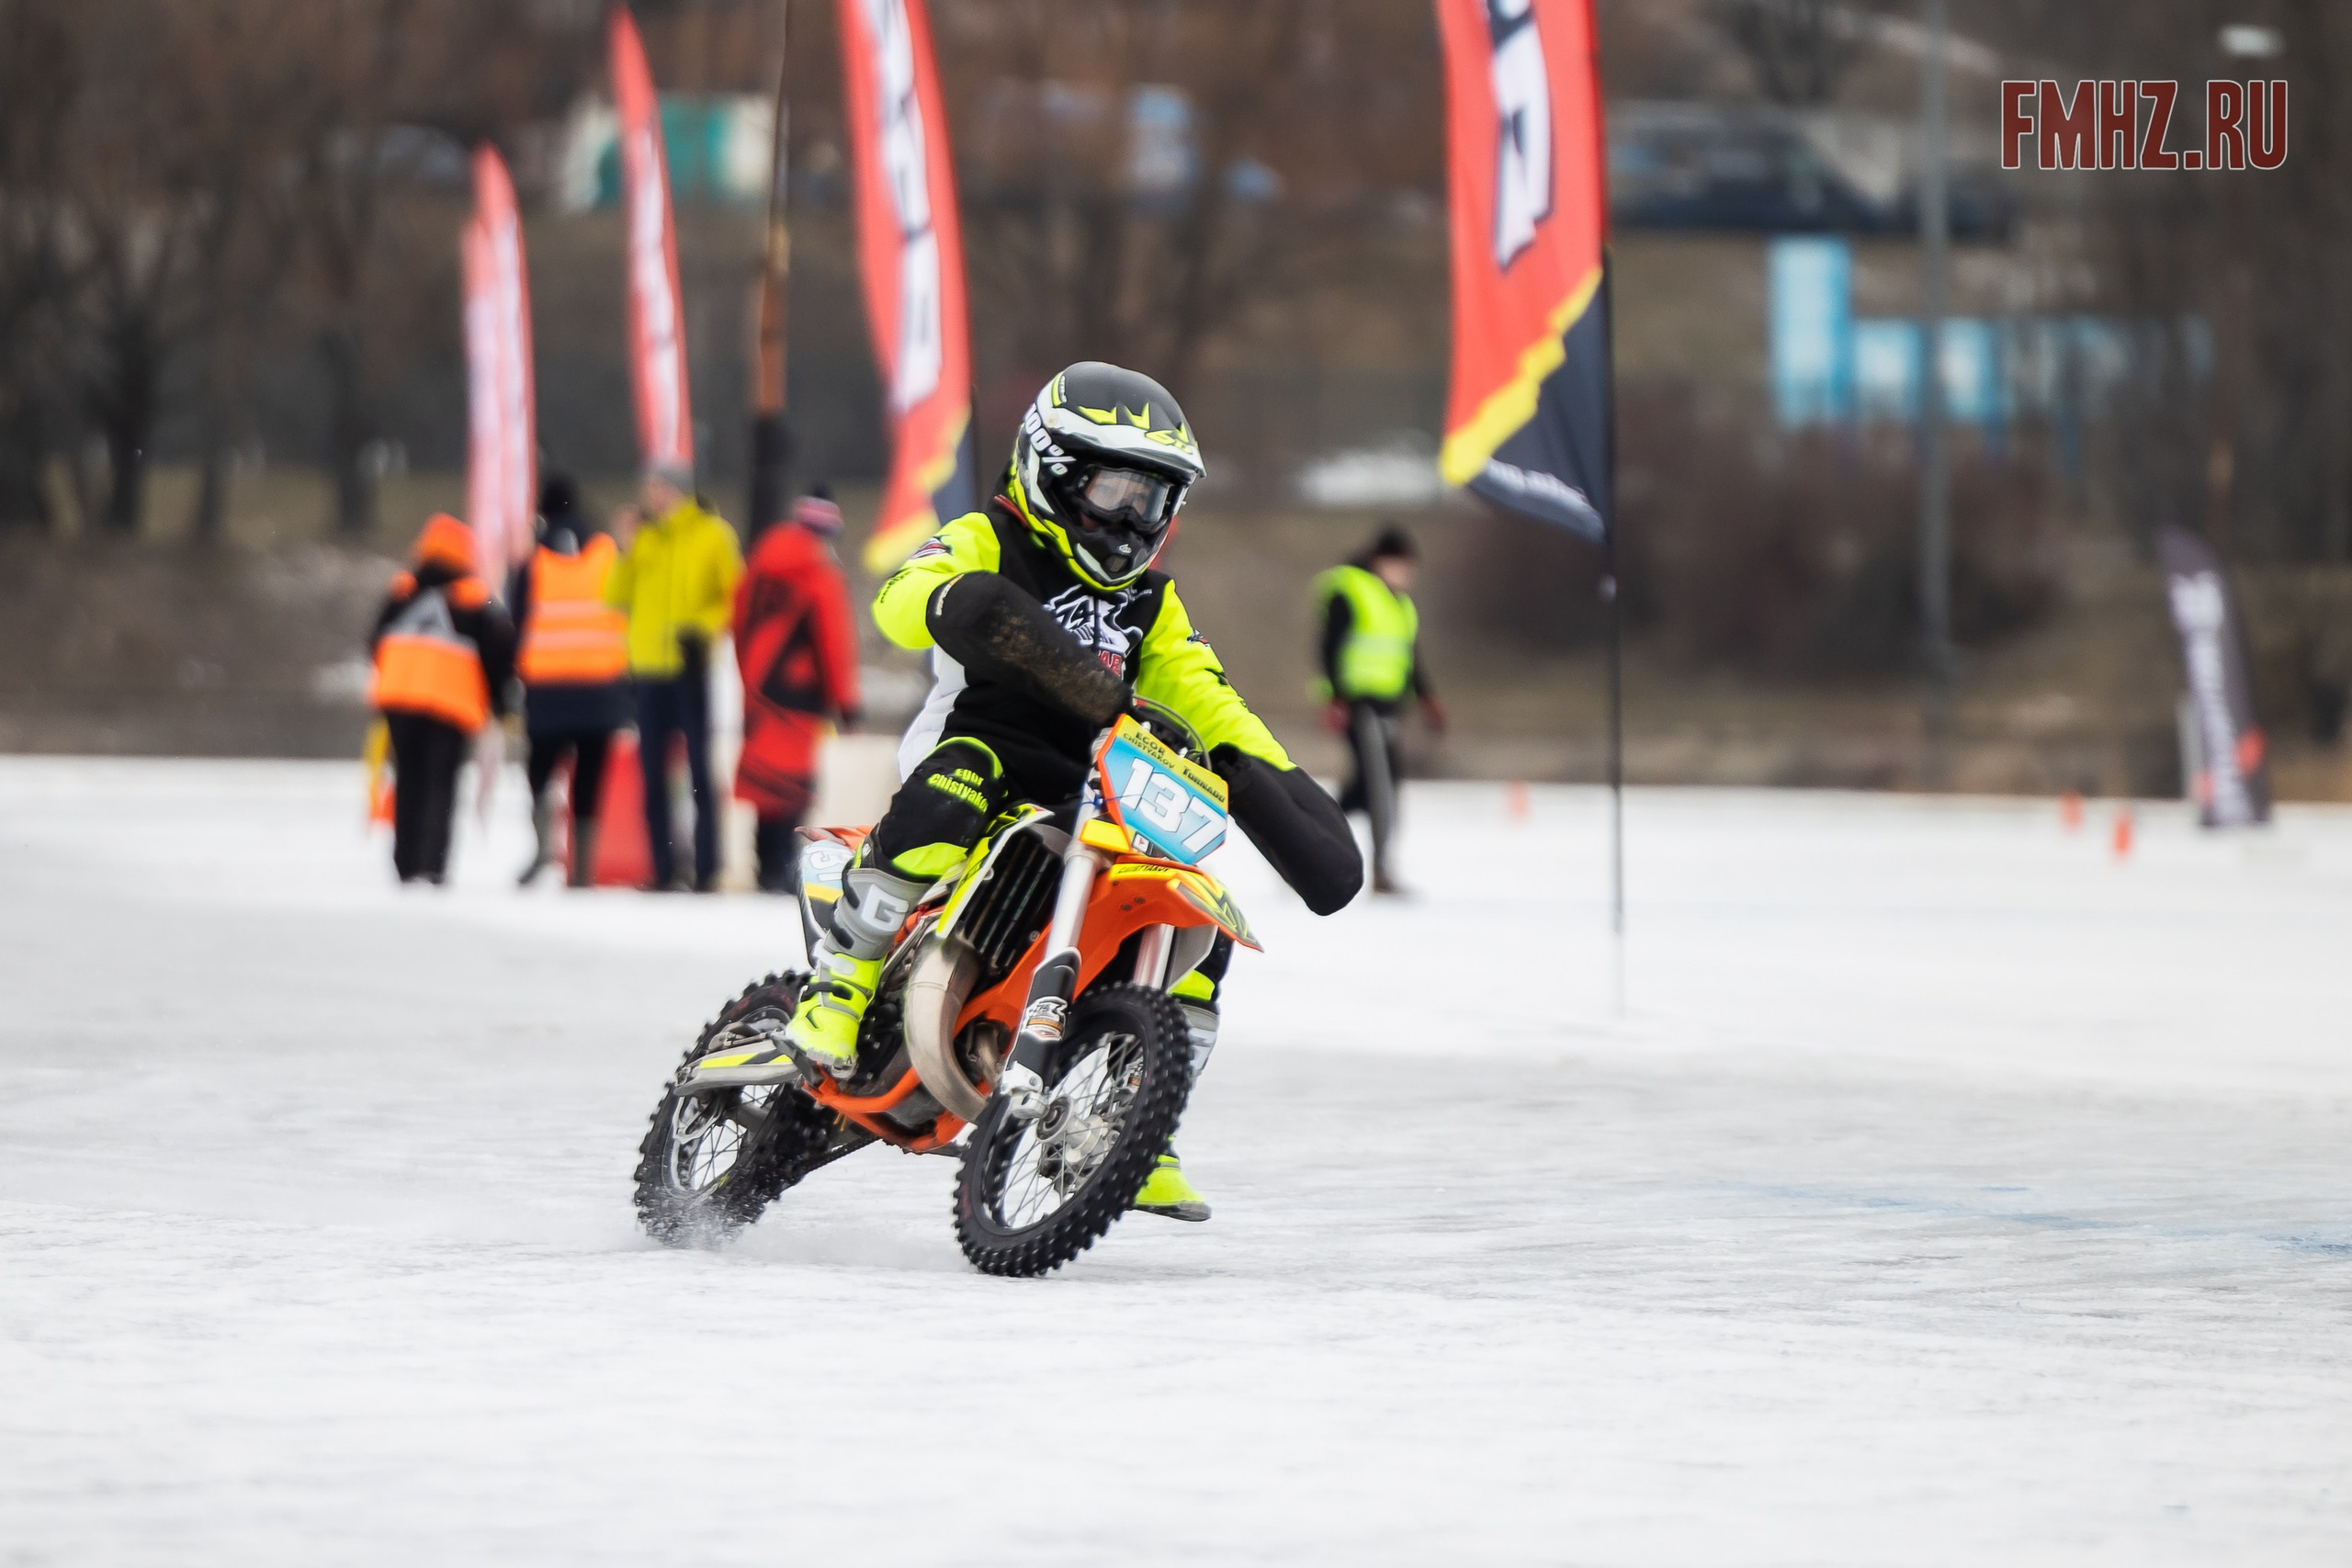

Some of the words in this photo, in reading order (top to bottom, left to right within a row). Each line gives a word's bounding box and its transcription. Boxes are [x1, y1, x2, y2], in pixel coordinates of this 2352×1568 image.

[1025, 402, 1077, 476] 100%
[1123, 733, 1176, 770] CHISTYAKOV
[1136, 731, 1166, 756] EGOR
[1120, 757, 1227, 854] 137
[861, 884, 909, 933] G
